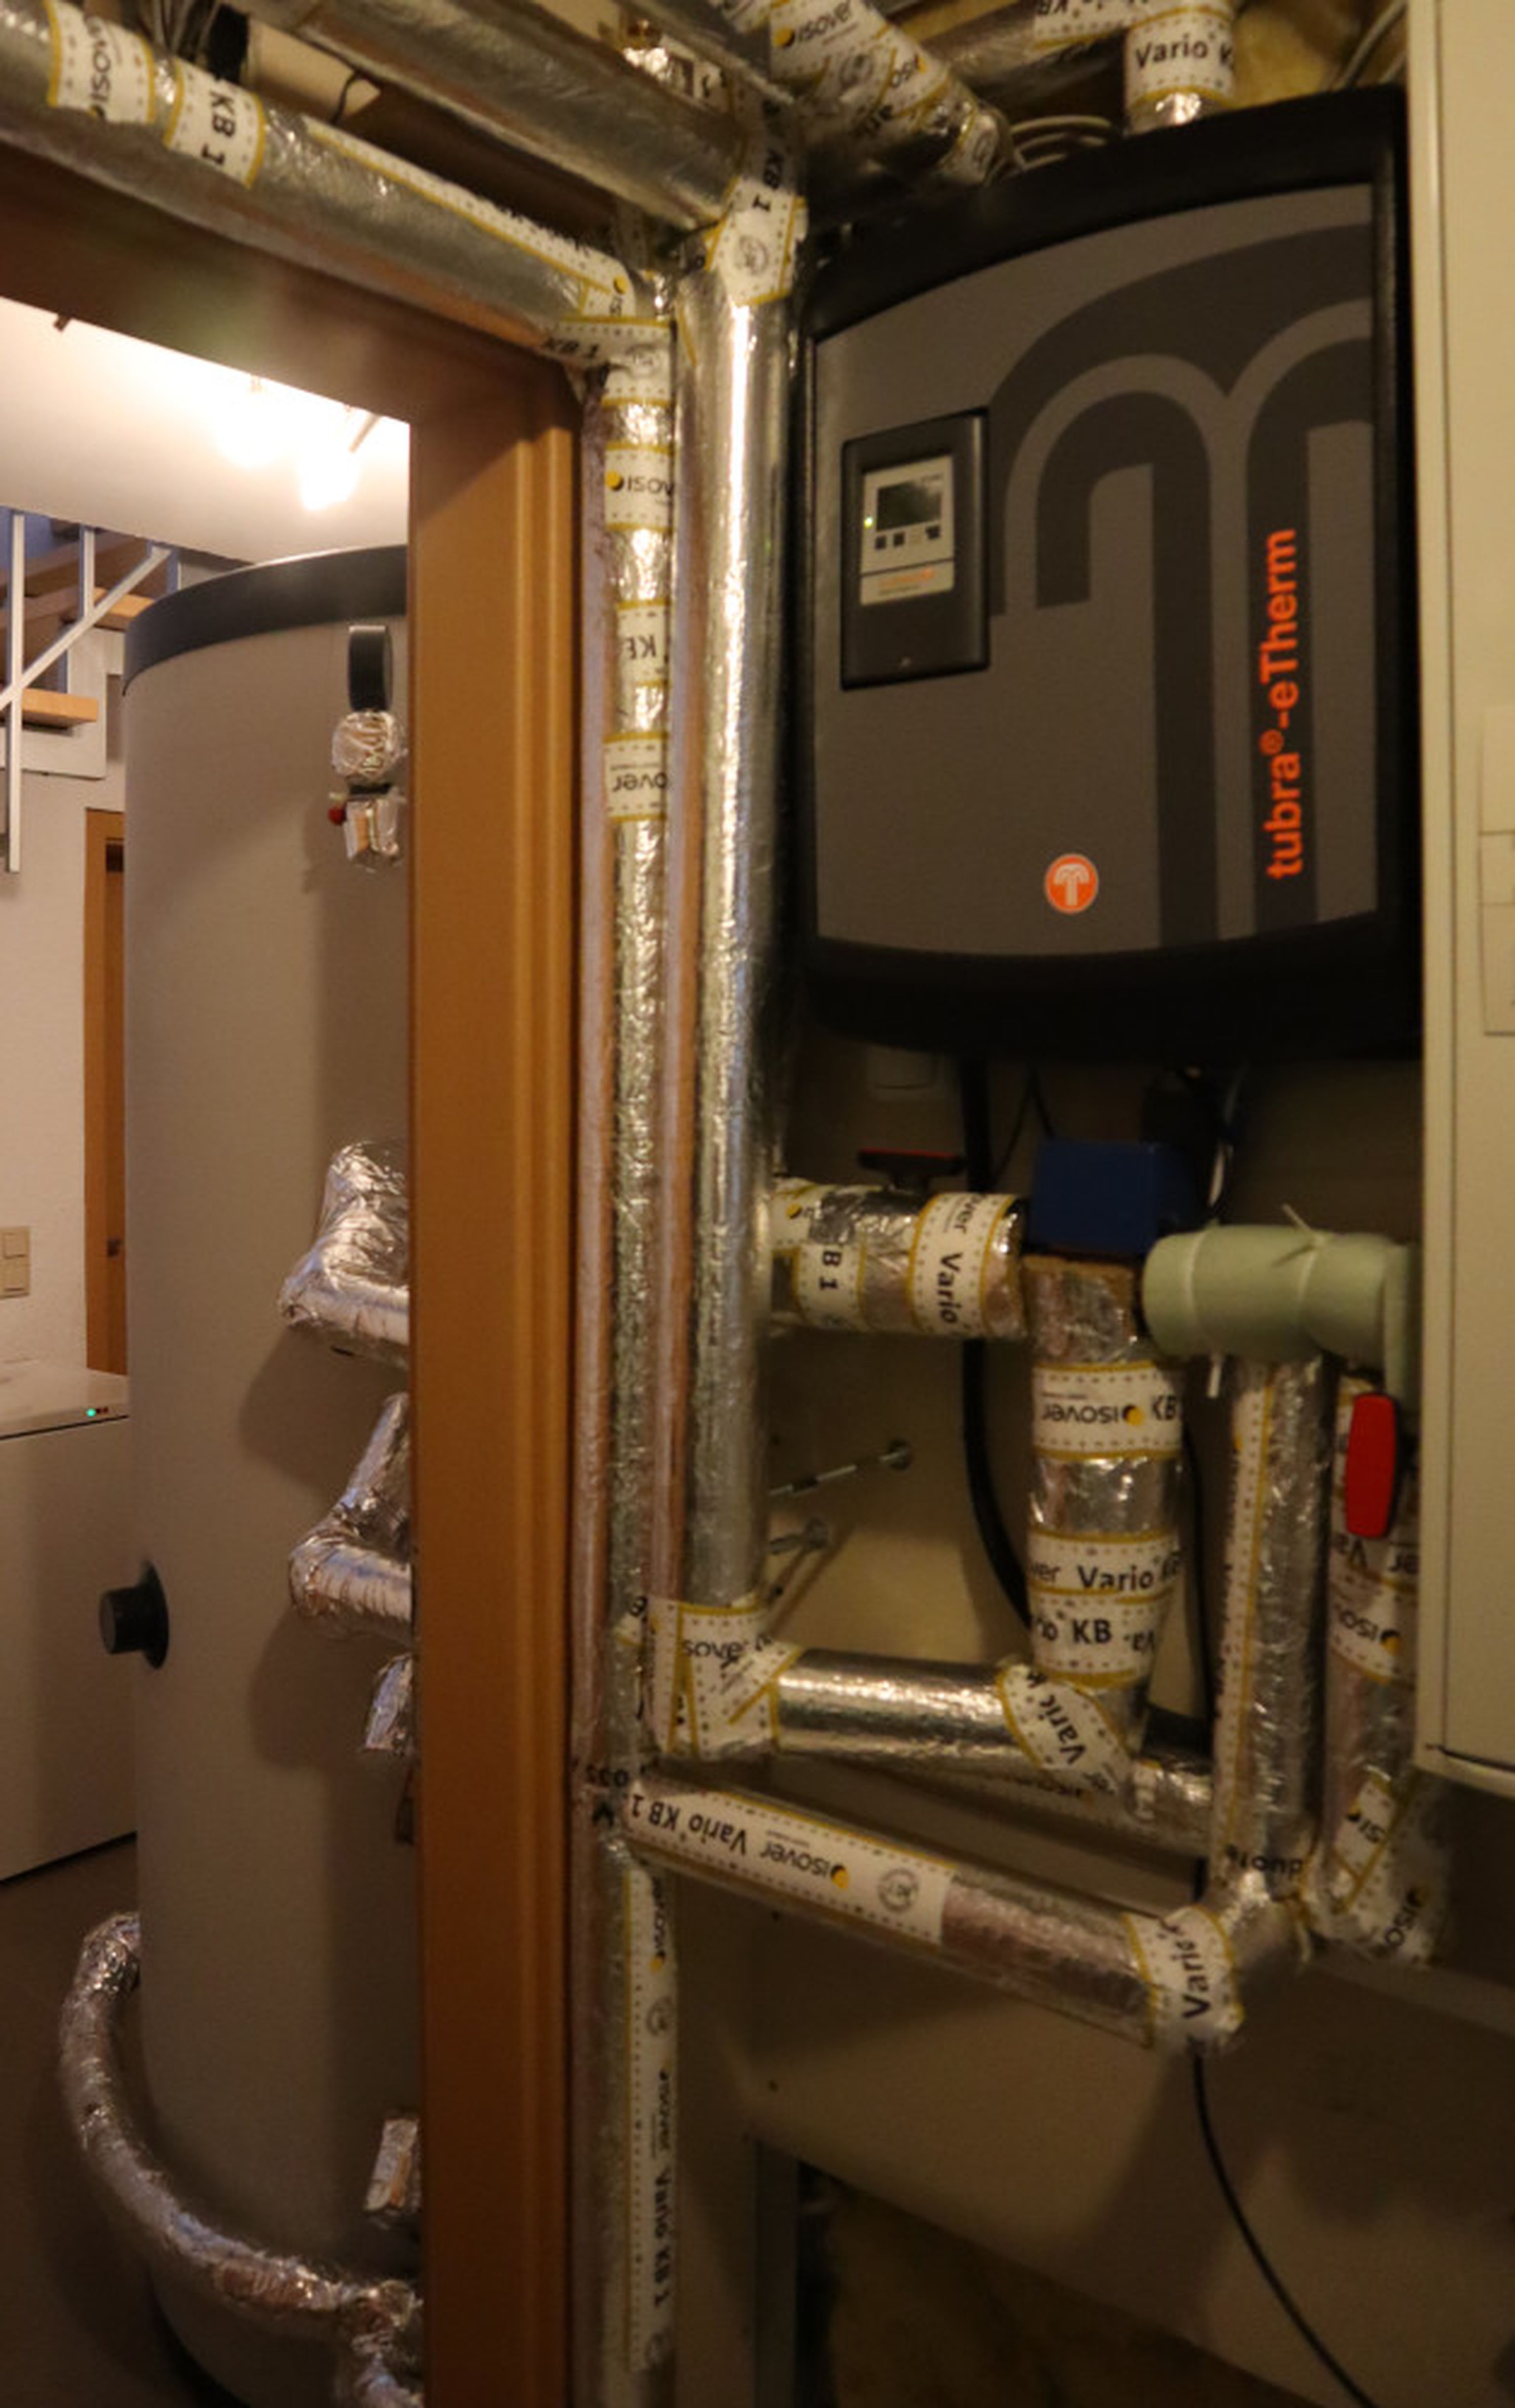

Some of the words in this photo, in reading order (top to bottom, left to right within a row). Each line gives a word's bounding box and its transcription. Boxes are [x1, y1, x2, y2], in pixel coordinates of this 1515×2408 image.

[1136, 33, 1208, 69] Vario
[210, 90, 236, 138] KB
[202, 144, 225, 165] 1
[753, 195, 770, 212] 1
[938, 1252, 962, 1324] Vario
[1042, 1403, 1118, 1424] isover
[1077, 1564, 1154, 1591] Vario
[1072, 1619, 1112, 1643] KB
[631, 1795, 644, 1817] 1
[649, 1801, 681, 1831] KB
[688, 1812, 748, 1857] Vario
[760, 1841, 831, 1879] isover
